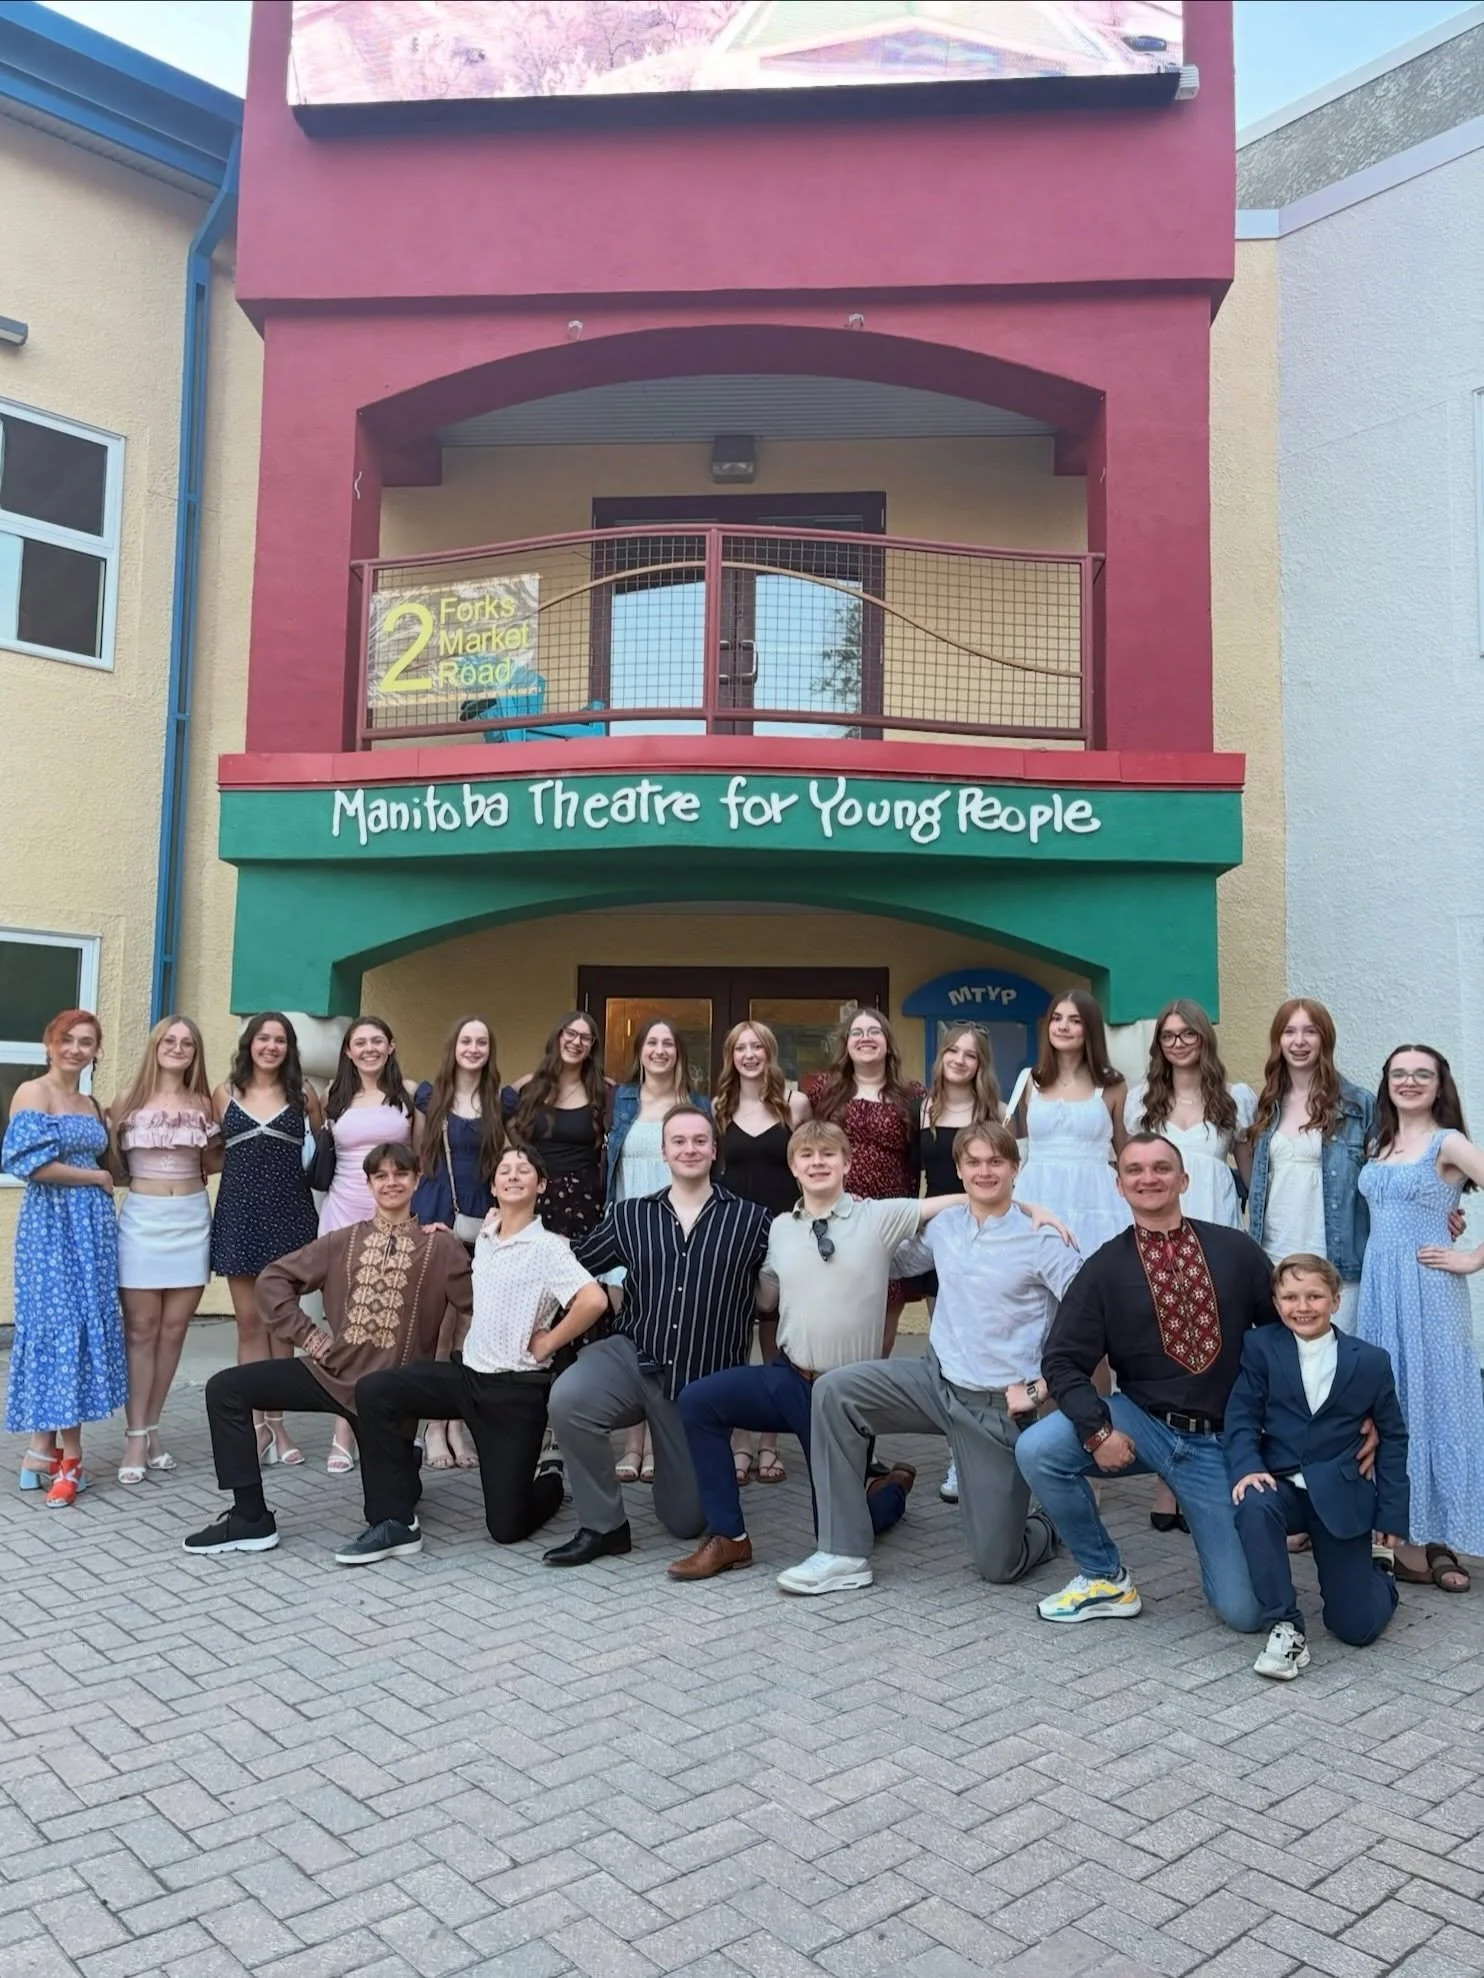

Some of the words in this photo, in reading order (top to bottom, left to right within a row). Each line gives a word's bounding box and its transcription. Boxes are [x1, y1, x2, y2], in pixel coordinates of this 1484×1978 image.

[440, 593, 516, 624] Forks
[379, 602, 434, 693] 2
[439, 621, 529, 656] Market
[438, 656, 511, 688] Road
[332, 784, 509, 846] Manitoba
[528, 778, 701, 830] Theatre
[719, 775, 799, 830] for
[809, 775, 952, 844] Young
[957, 787, 1101, 844] People
[948, 985, 1017, 1006] MTYP
